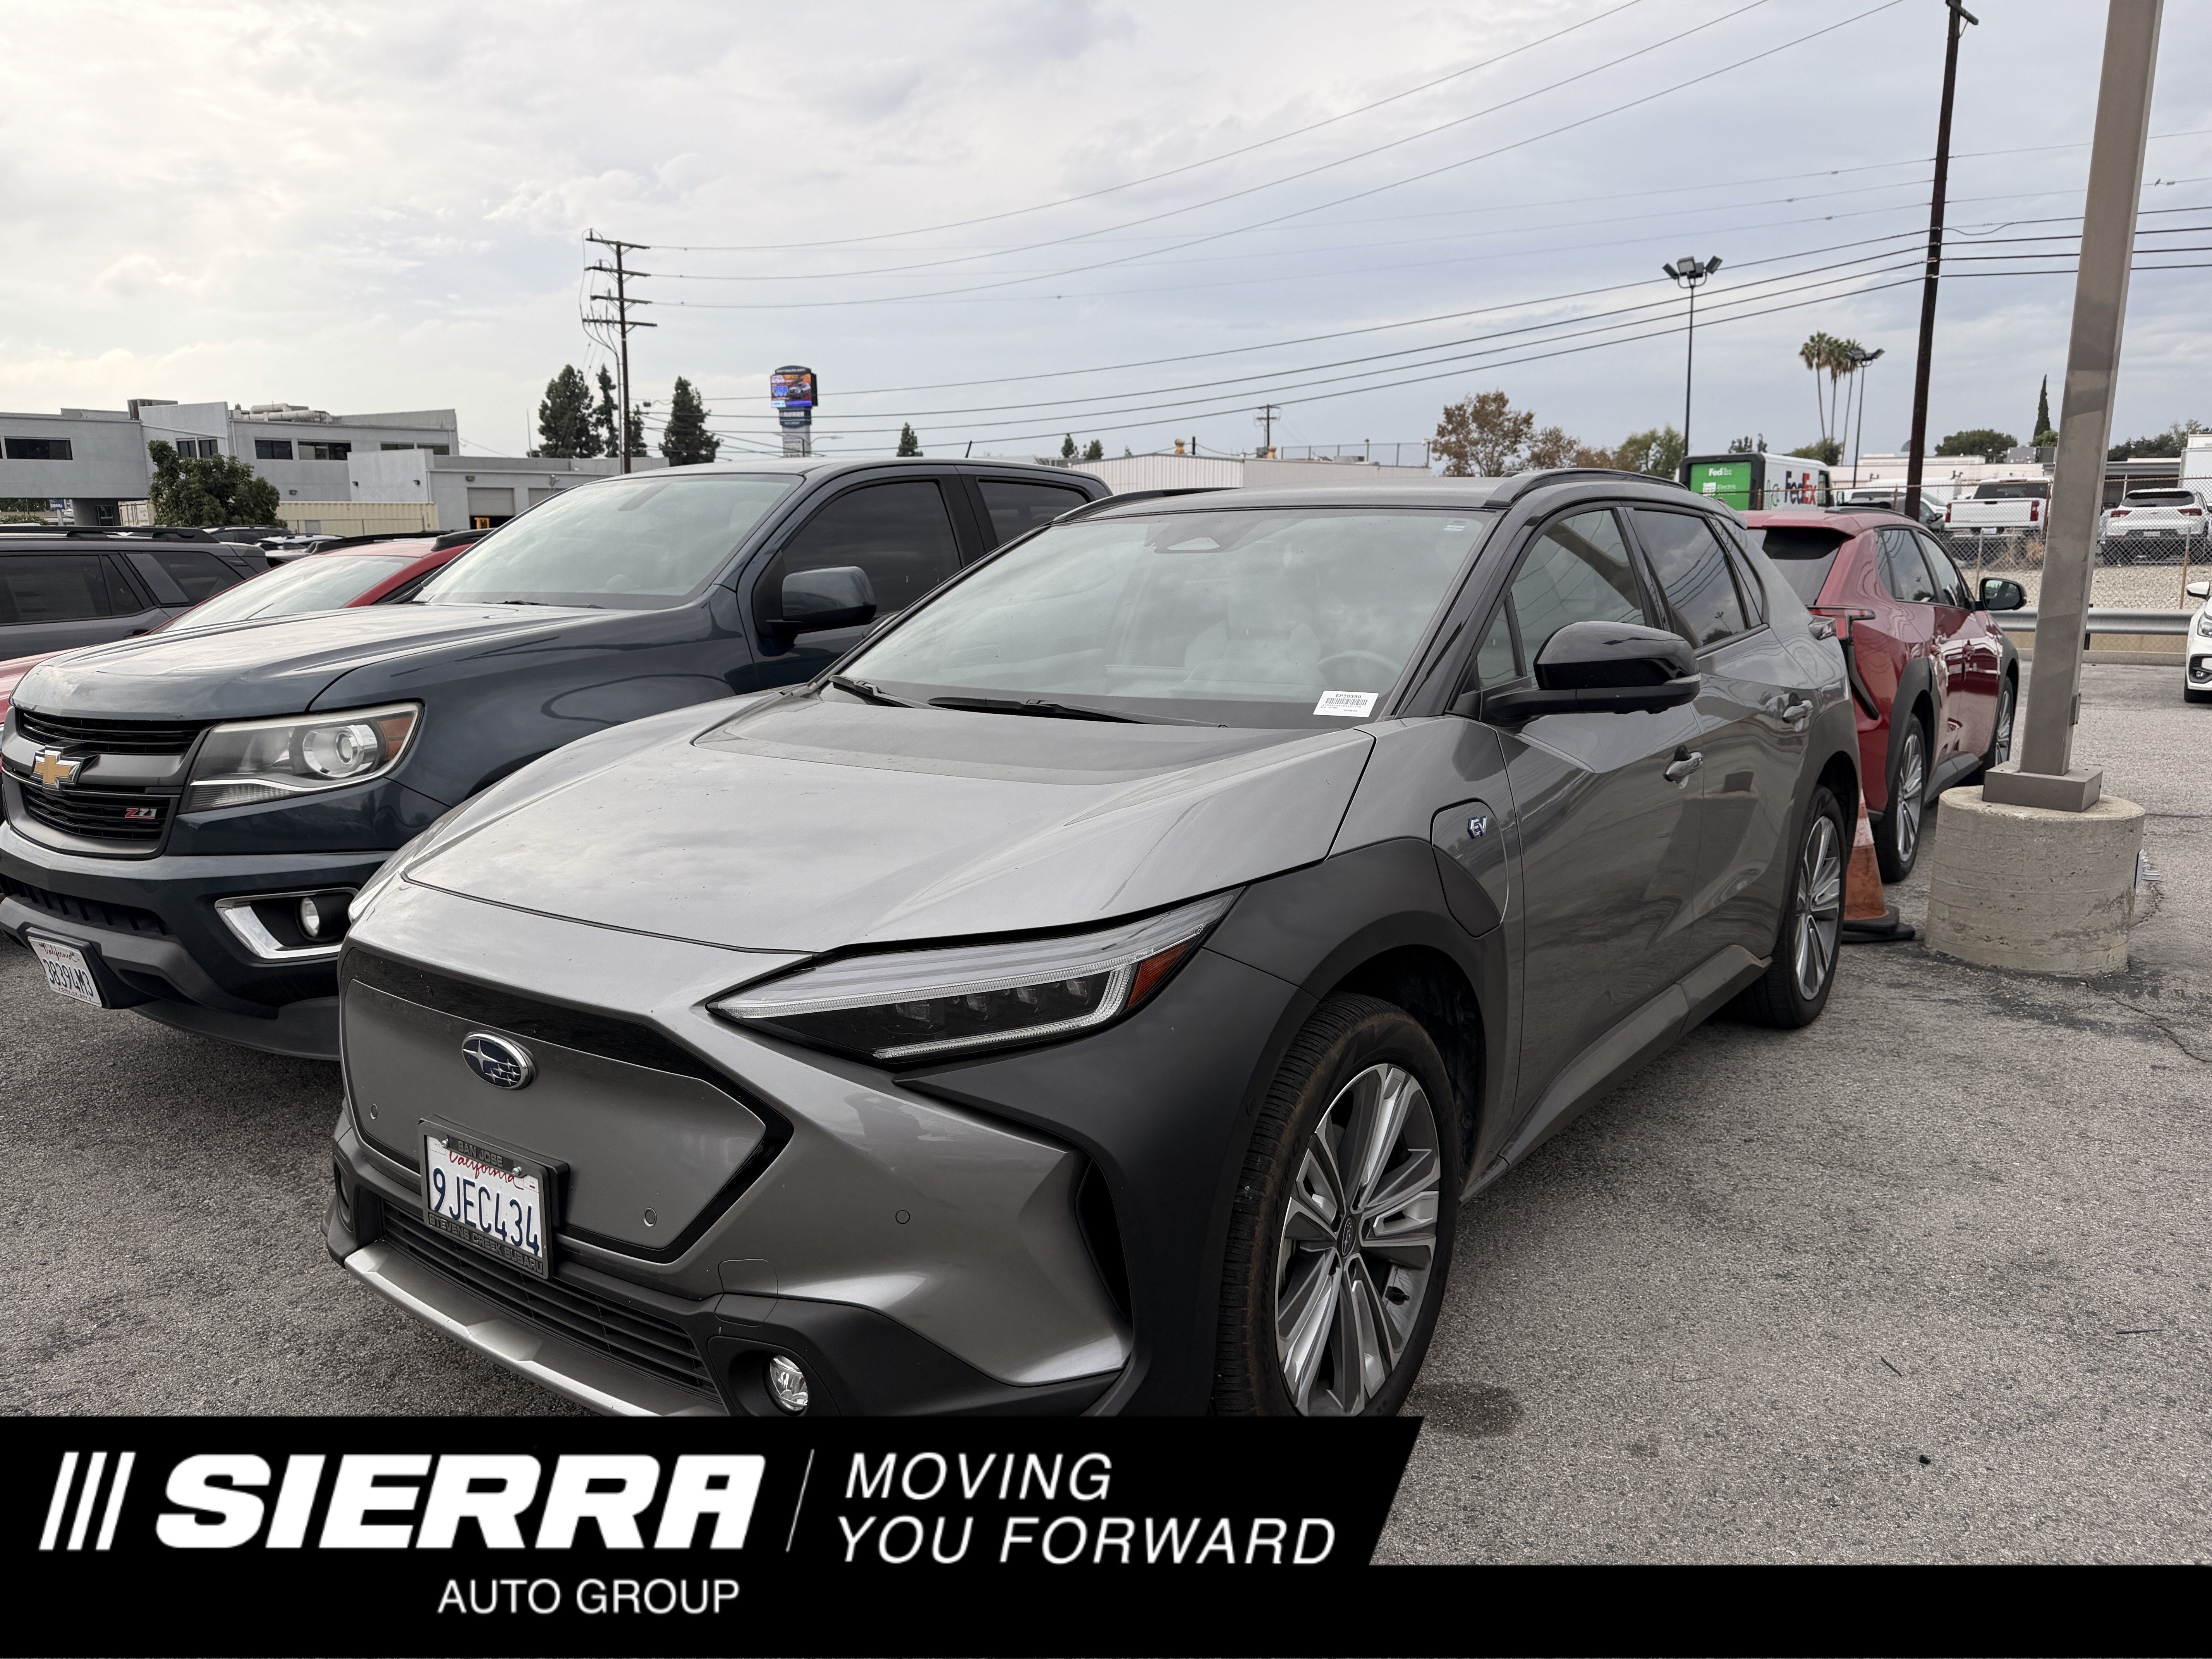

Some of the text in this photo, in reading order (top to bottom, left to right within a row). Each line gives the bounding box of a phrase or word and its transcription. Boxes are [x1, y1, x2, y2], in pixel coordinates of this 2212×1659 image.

[1709, 467, 1732, 476] FedEx
[1785, 471, 1816, 505] FedEx
[125, 808, 157, 819] Z71
[43, 958, 93, 997] 38394M3
[458, 1140, 503, 1168] SAN JOSE
[433, 1168, 539, 1255] 9JEC434
[429, 1214, 543, 1274] STEVENS CREEK SUBARU
